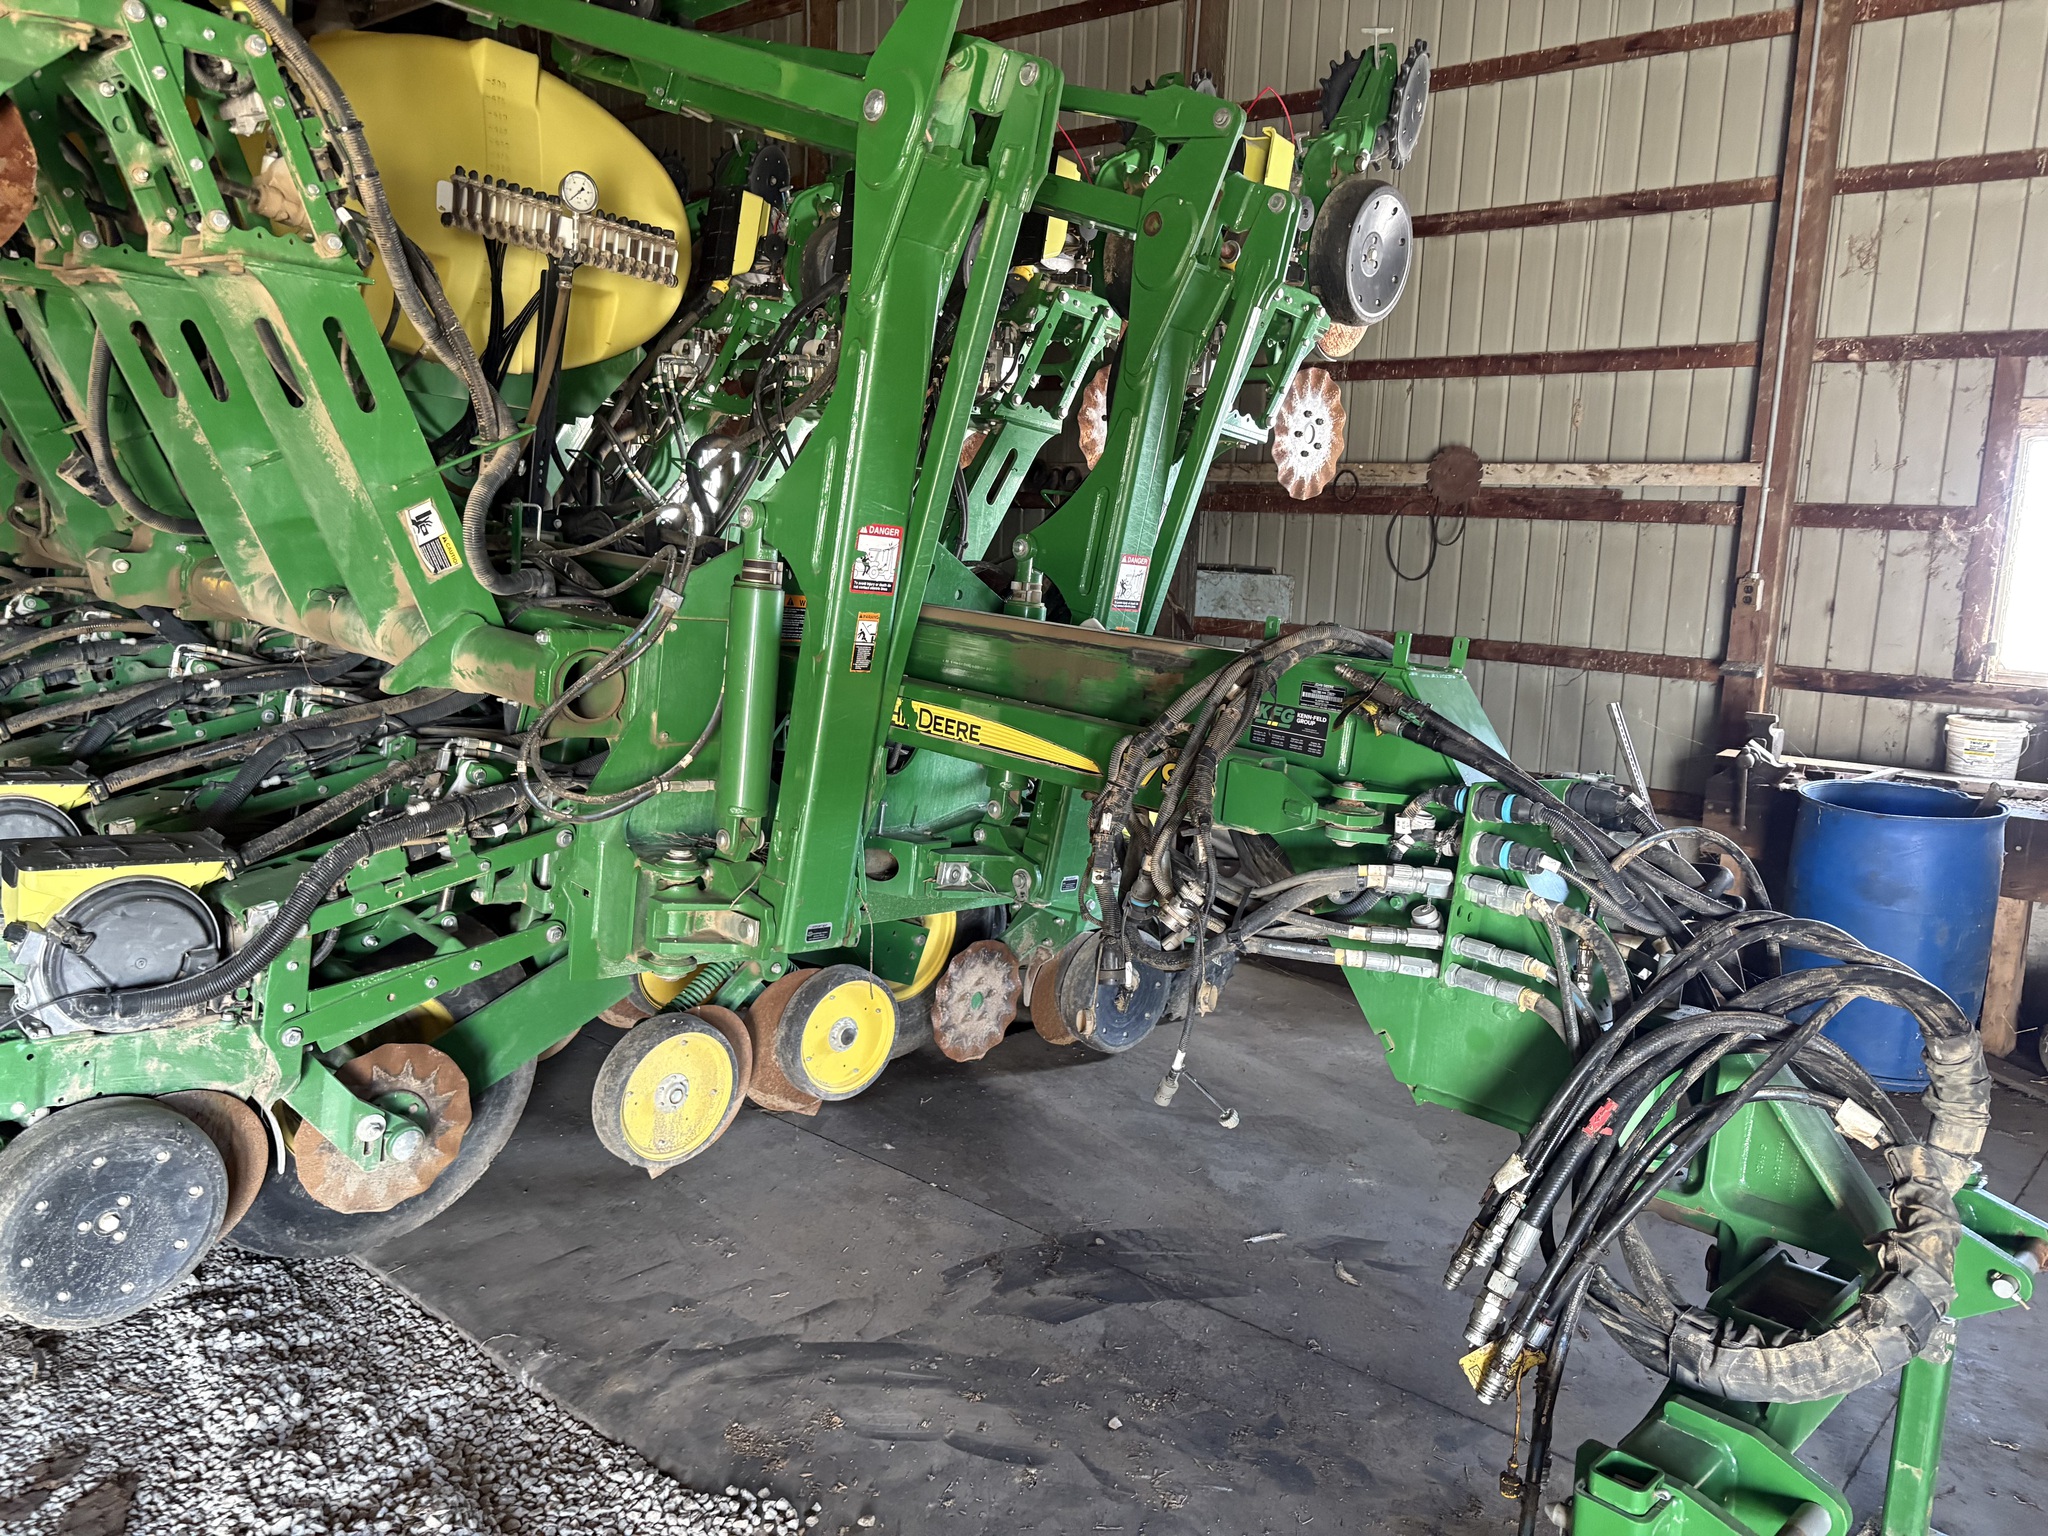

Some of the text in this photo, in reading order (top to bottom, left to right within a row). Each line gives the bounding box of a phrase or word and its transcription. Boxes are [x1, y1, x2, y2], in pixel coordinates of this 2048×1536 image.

[869, 526, 900, 536] DANGER
[1296, 712, 1327, 723] KENN-FELD
[1296, 718, 1316, 726] GROUP
[918, 707, 981, 742] DEERE
